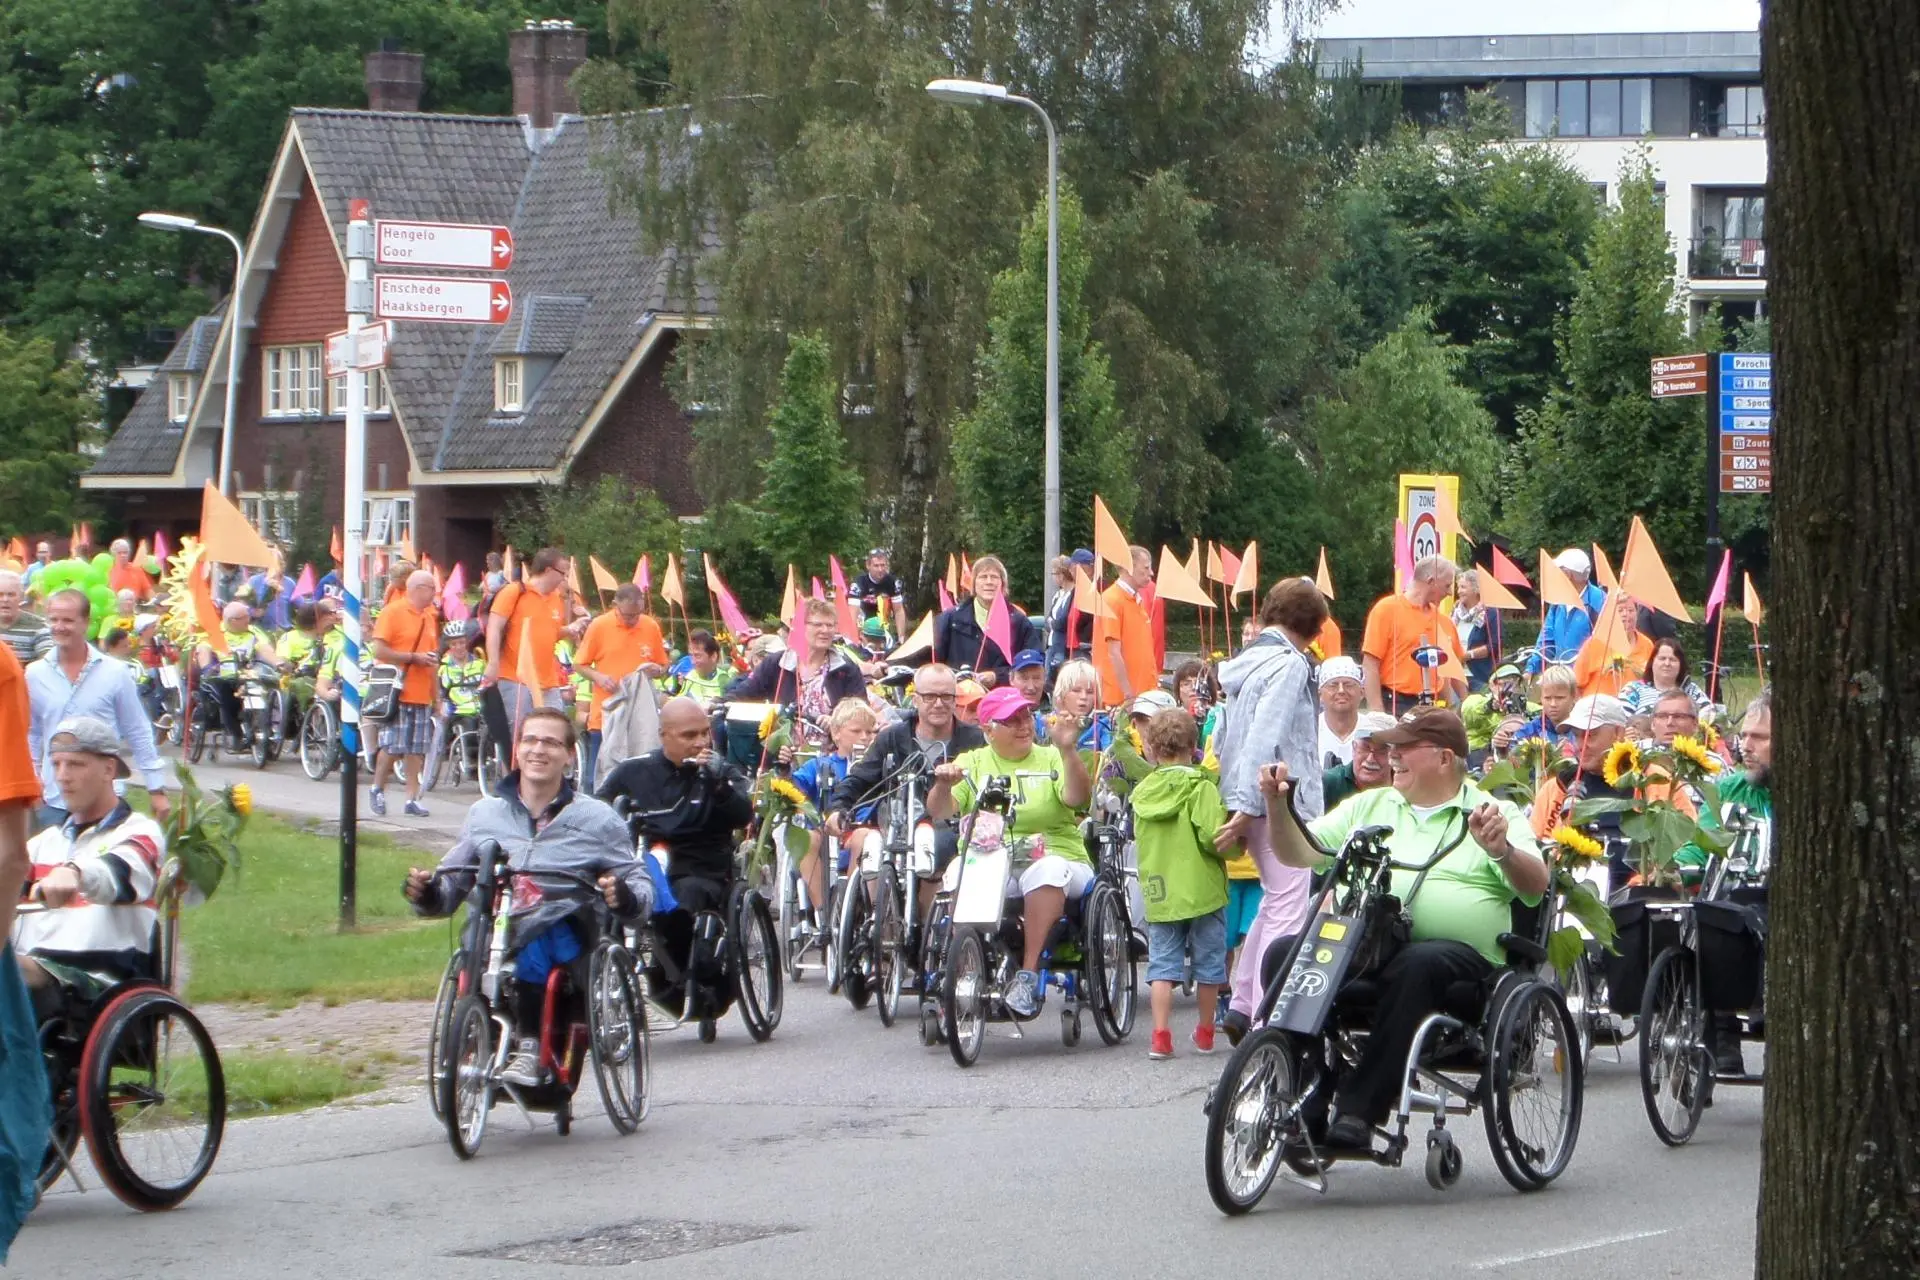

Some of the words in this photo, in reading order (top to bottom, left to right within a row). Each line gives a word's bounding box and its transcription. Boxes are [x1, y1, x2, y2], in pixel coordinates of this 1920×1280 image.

[383, 227, 436, 242] Hengelo
[383, 245, 413, 257] Goor
[382, 281, 441, 295] Enschede
[382, 299, 463, 316] Haaksbergen
[1735, 359, 1771, 369] Parochi
[1418, 495, 1436, 508] ZONE
[1415, 538, 1434, 561] 30
